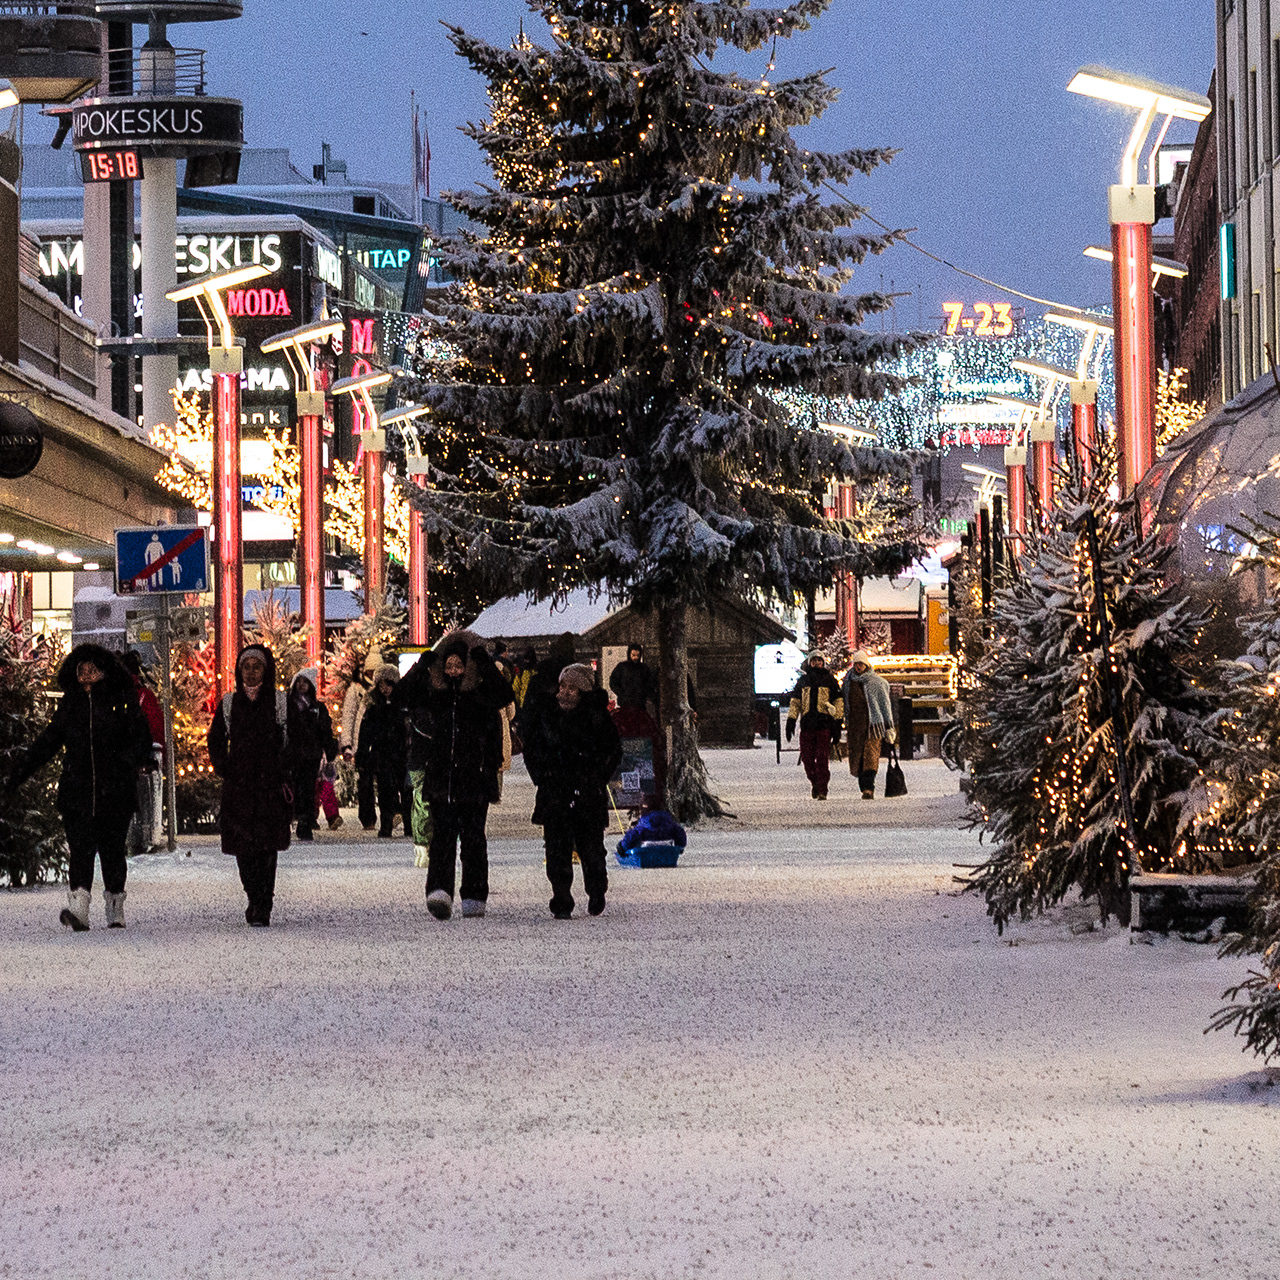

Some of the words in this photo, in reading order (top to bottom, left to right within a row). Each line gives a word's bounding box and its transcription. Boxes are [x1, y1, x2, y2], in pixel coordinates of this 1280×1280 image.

[88, 152, 138, 180] 15:18
[226, 287, 291, 317] MODA
[942, 302, 1013, 336] 7-23
